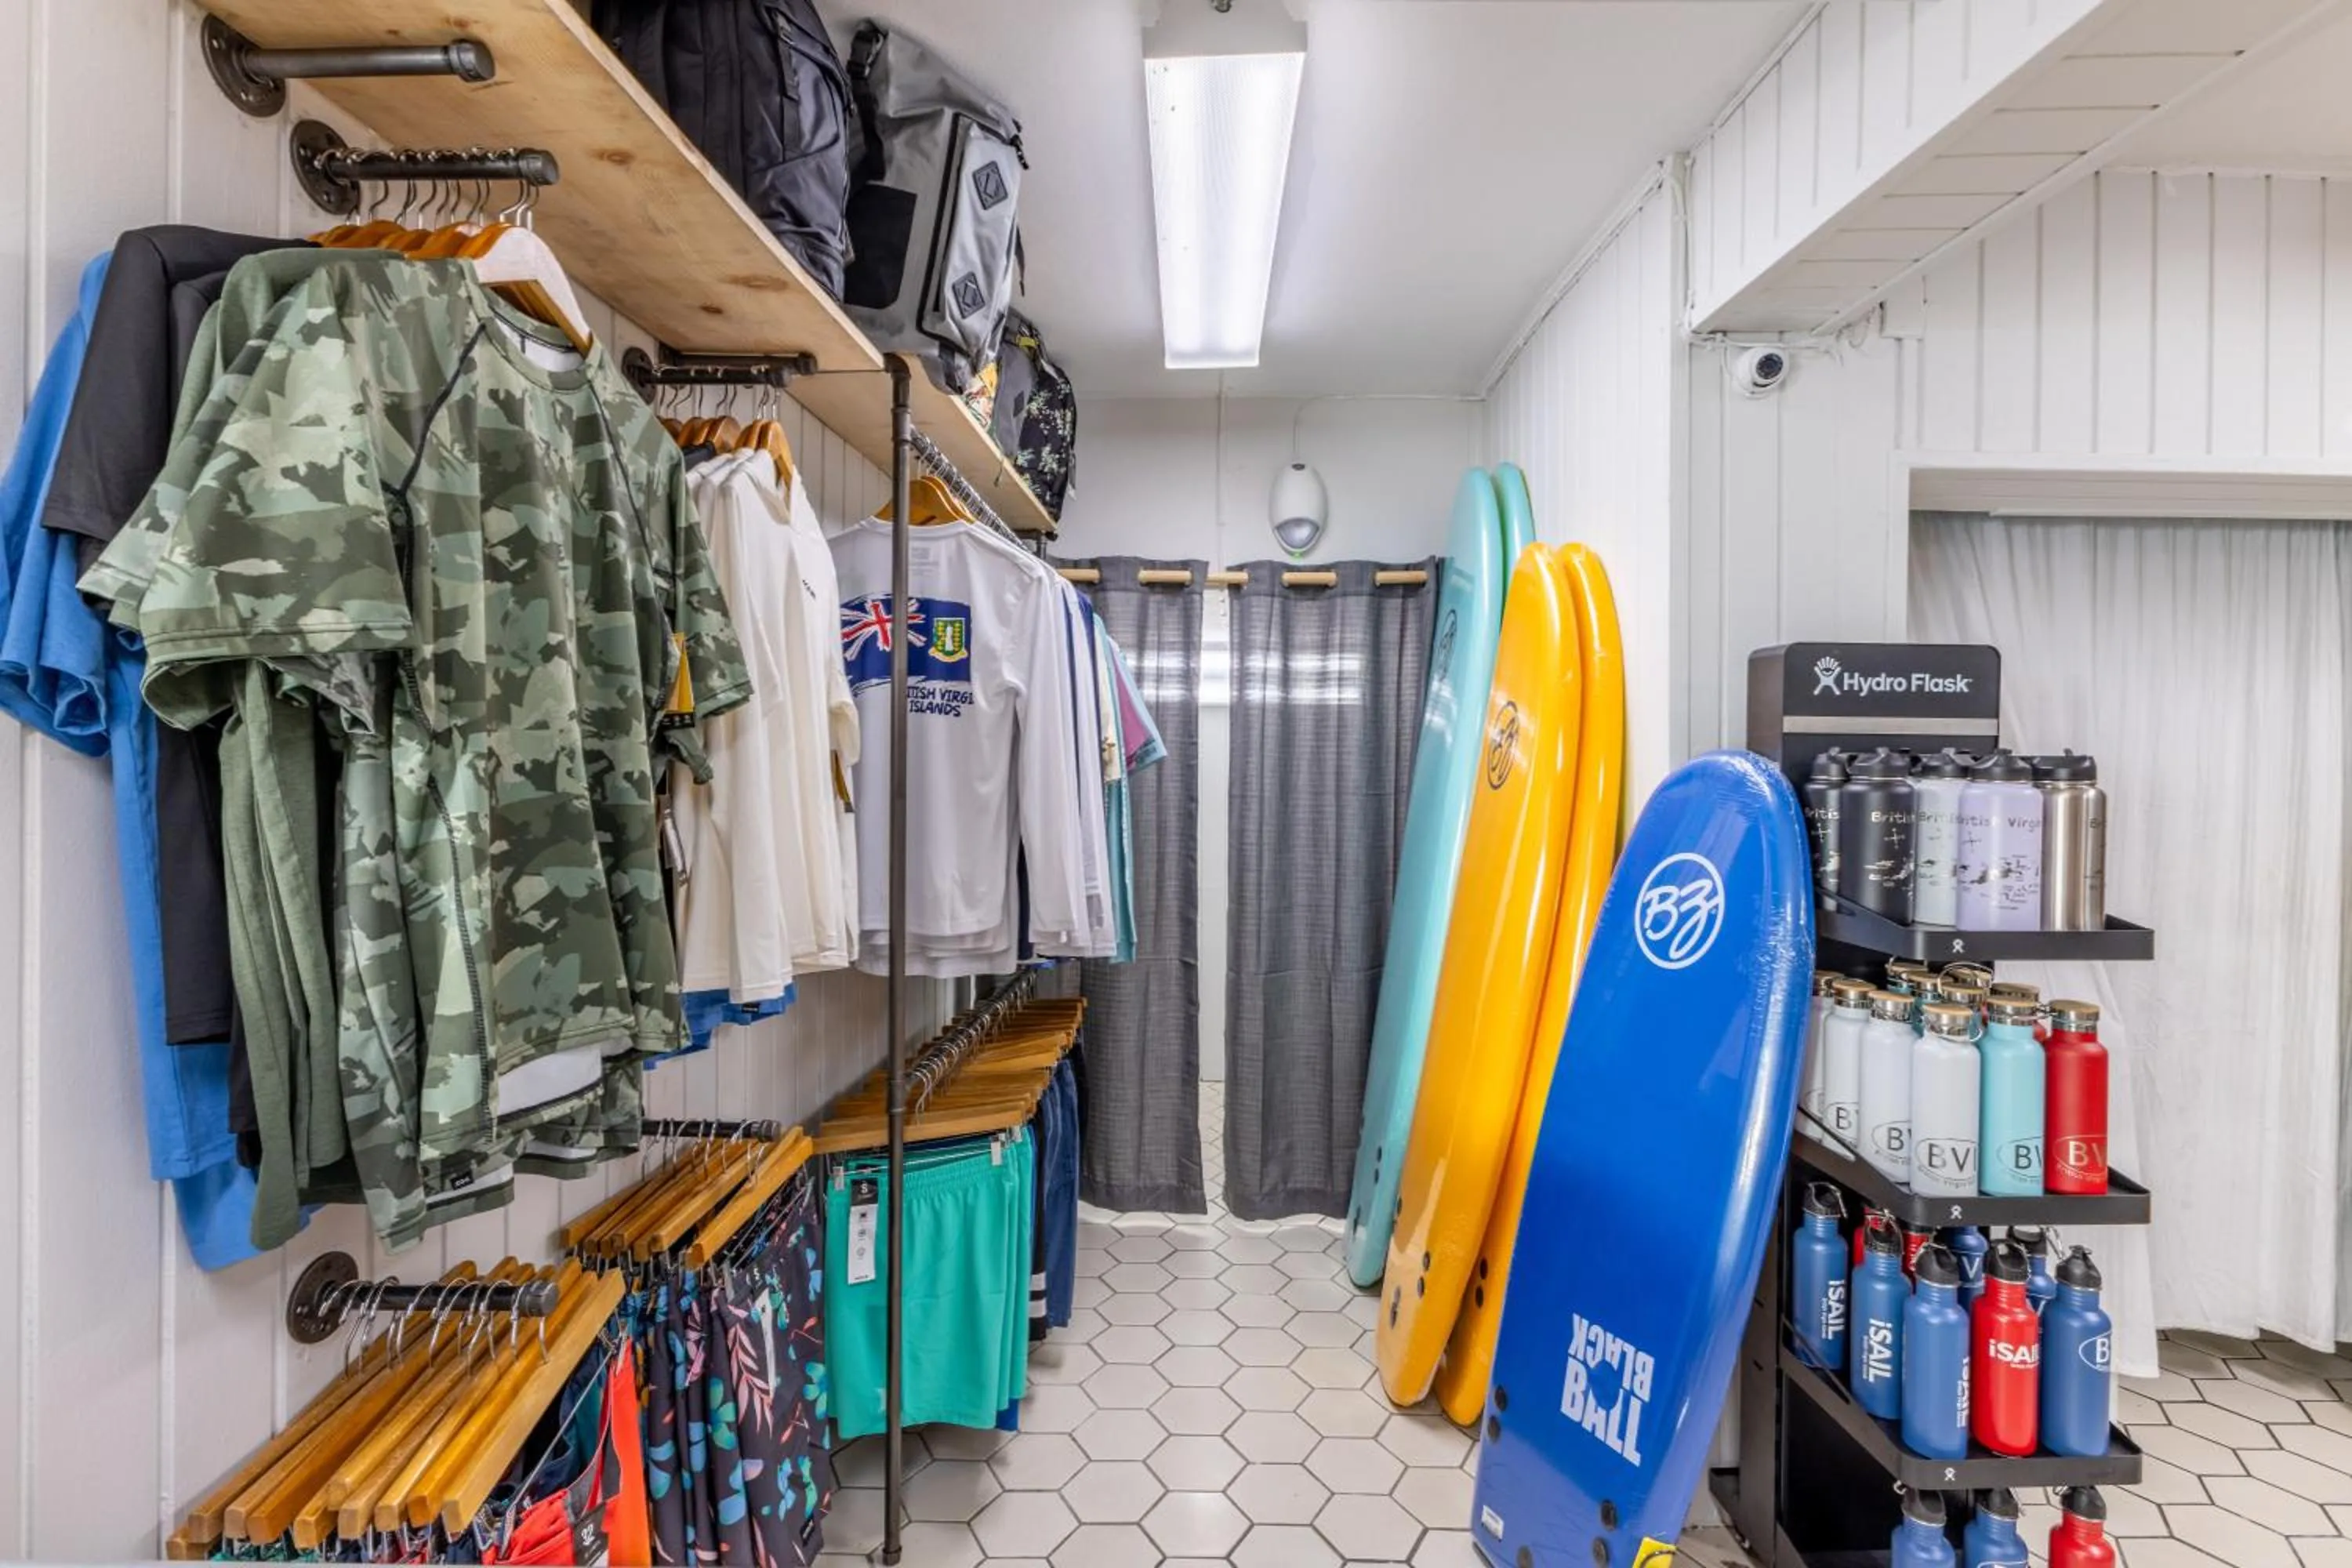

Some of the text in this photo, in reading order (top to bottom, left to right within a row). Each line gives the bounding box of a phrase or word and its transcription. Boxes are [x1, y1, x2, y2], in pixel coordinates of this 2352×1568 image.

[940, 688, 975, 705] VIRGI
[1843, 672, 1970, 696] Hydro Flask
[909, 700, 961, 717] ISLANDS
[1567, 1312, 1655, 1403] BLACK
[1868, 1317, 1893, 1383] iSAIL
[1560, 1356, 1642, 1468] BALL
